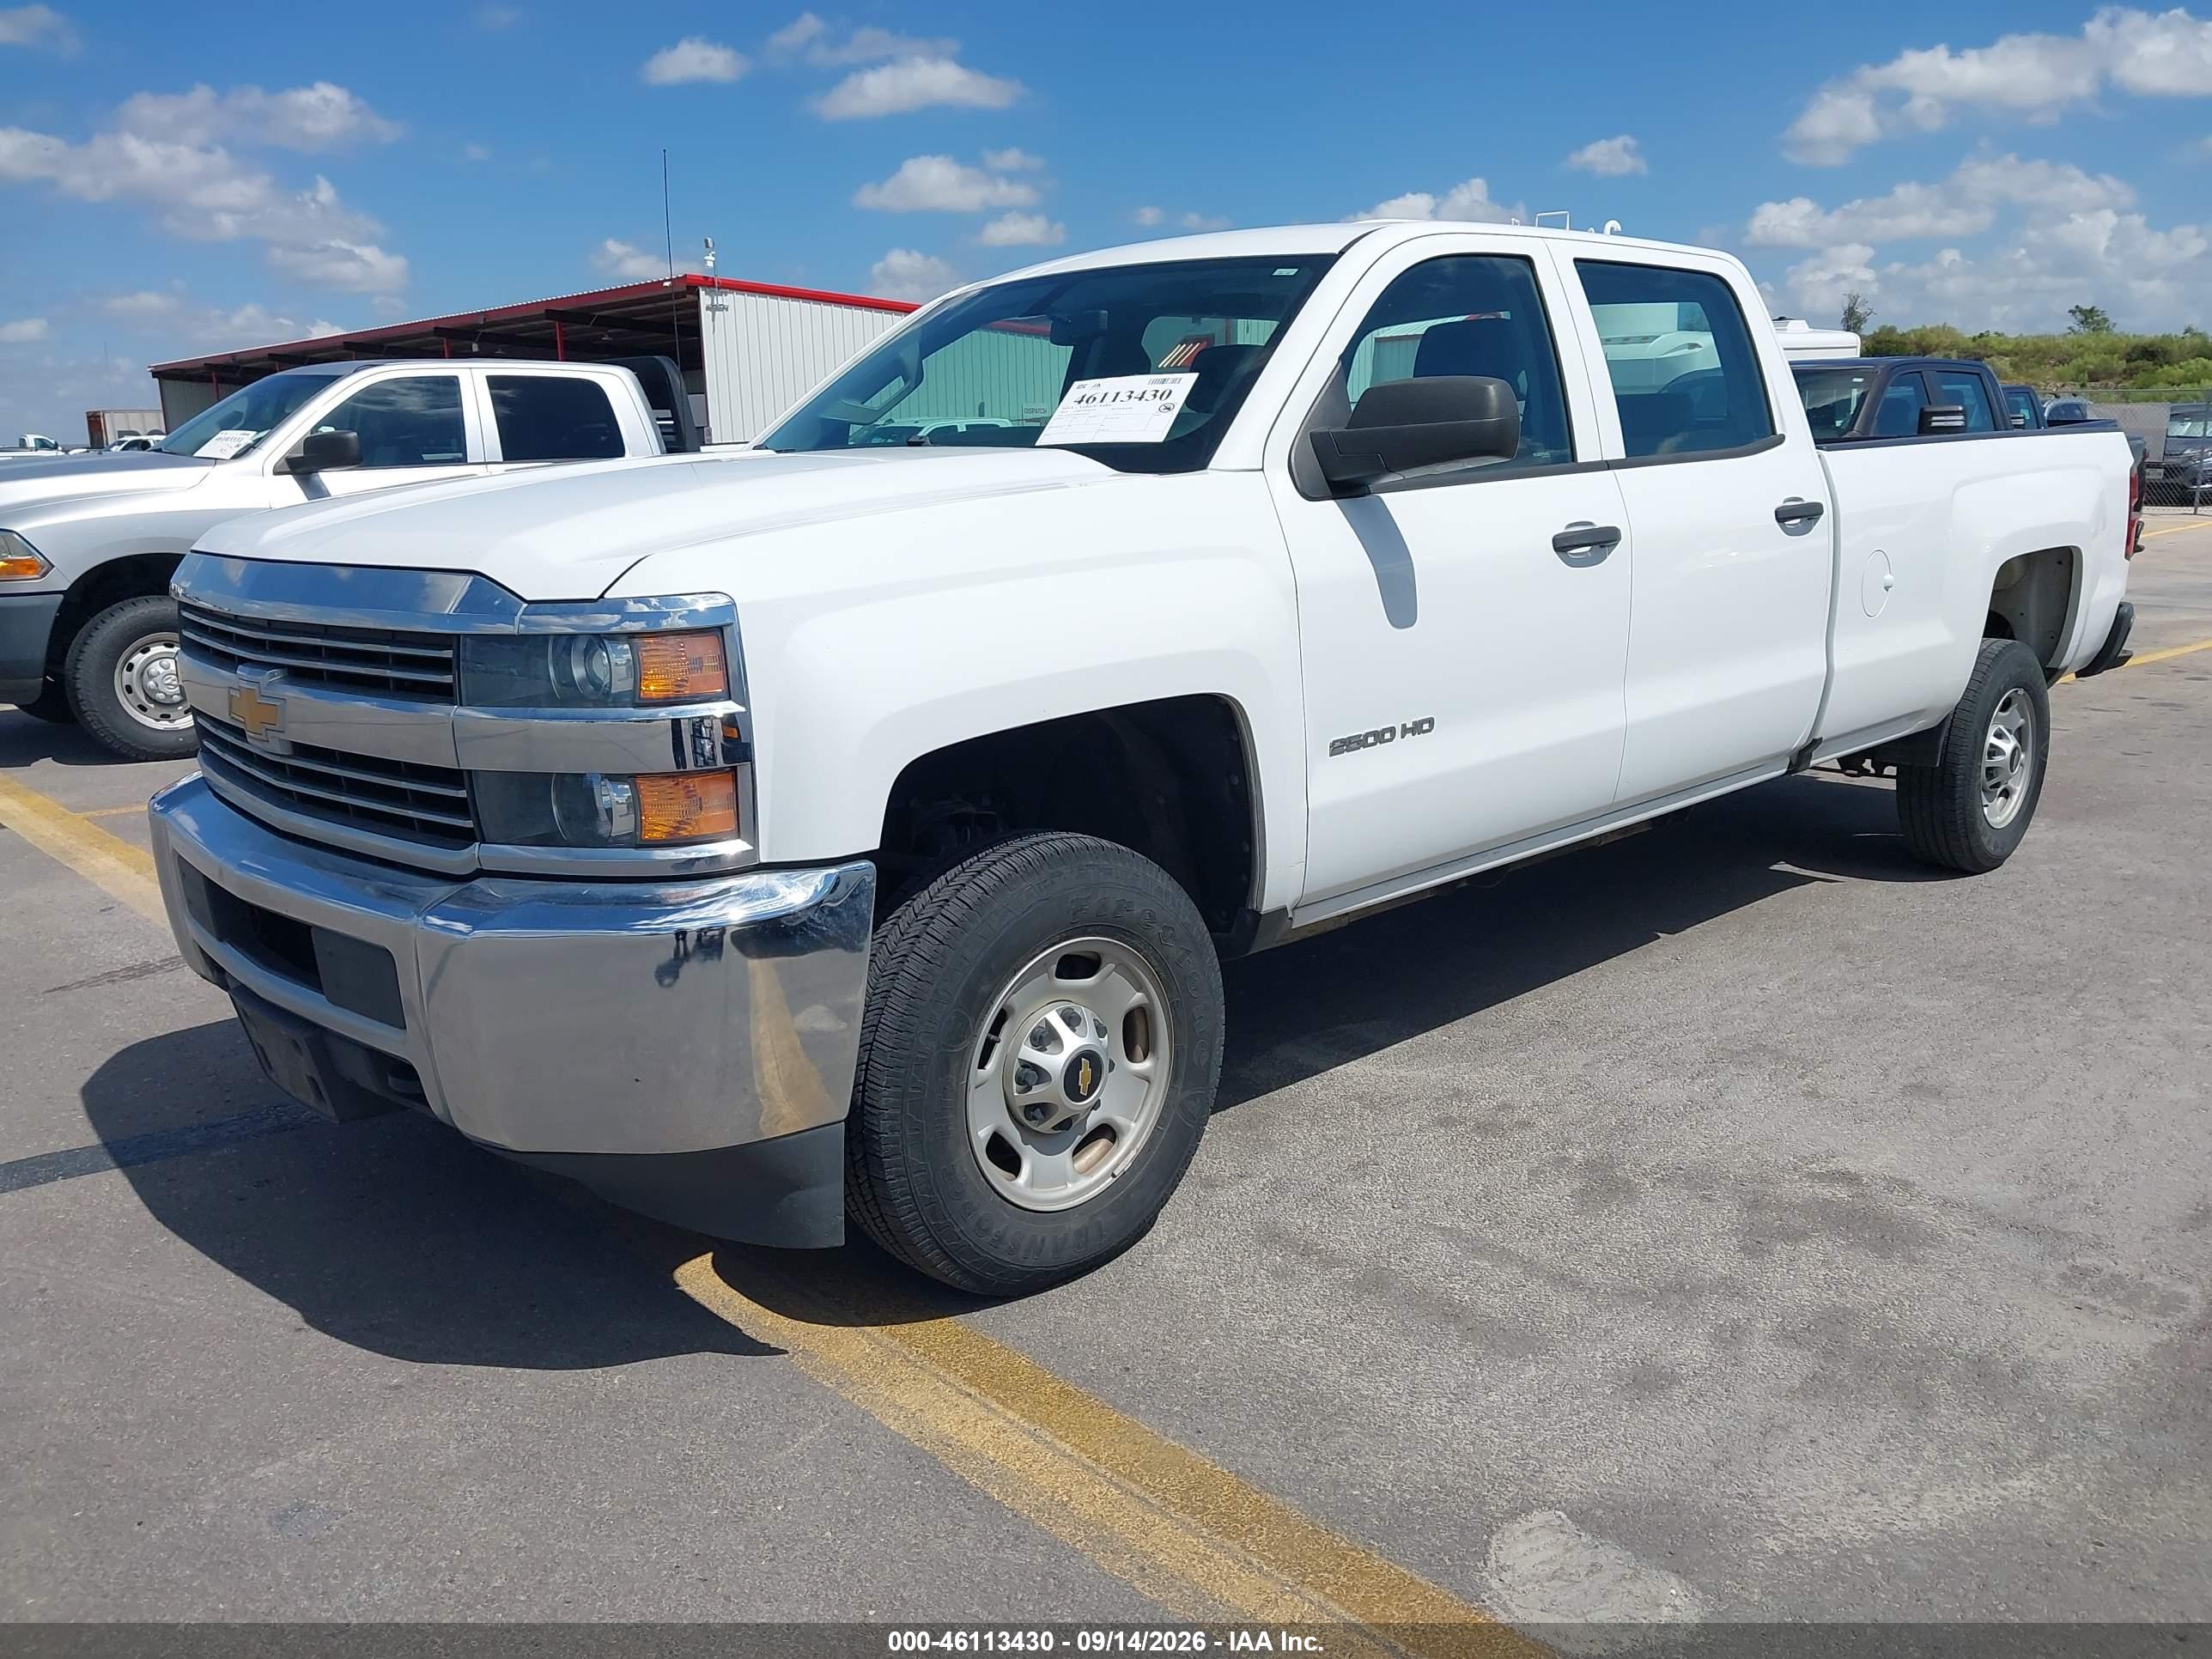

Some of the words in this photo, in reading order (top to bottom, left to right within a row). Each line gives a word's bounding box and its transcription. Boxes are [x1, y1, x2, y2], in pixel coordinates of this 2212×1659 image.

[1074, 389, 1173, 404] 46113430
[1329, 726, 1396, 757] 2500
[1401, 716, 1435, 739] HD
[1067, 896, 1211, 1069] Firestone
